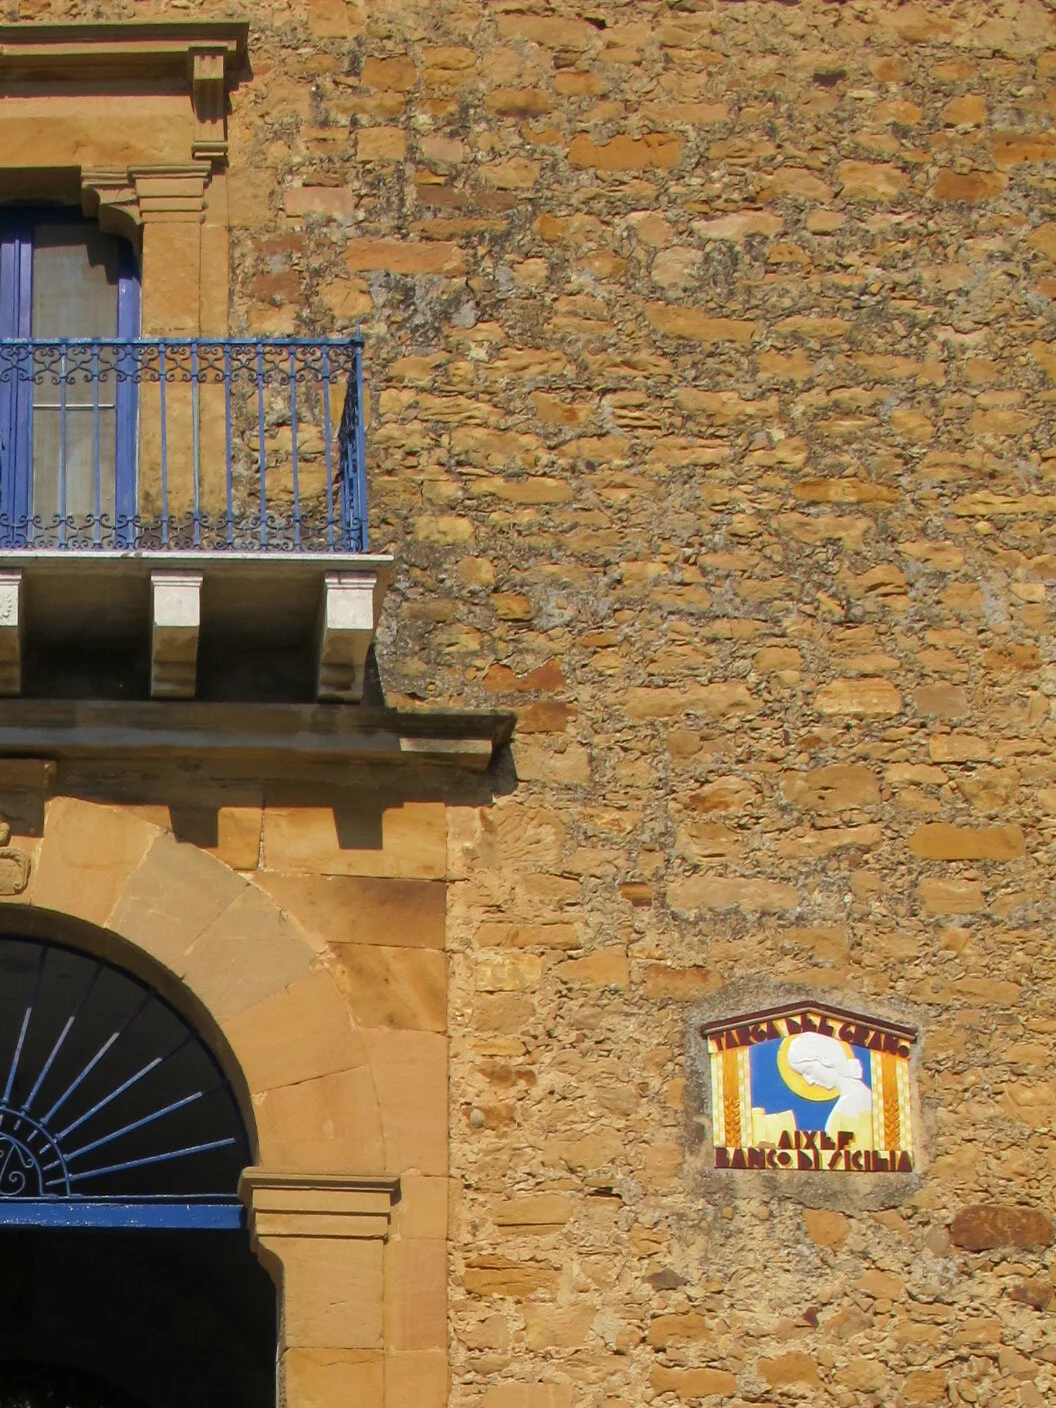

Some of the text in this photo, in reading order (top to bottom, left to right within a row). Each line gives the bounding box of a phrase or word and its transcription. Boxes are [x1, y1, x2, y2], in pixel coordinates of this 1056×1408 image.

[709, 1014, 911, 1058] TARGA DEL GRANO
[715, 1147, 914, 1172] BANCO DI SICILIA
